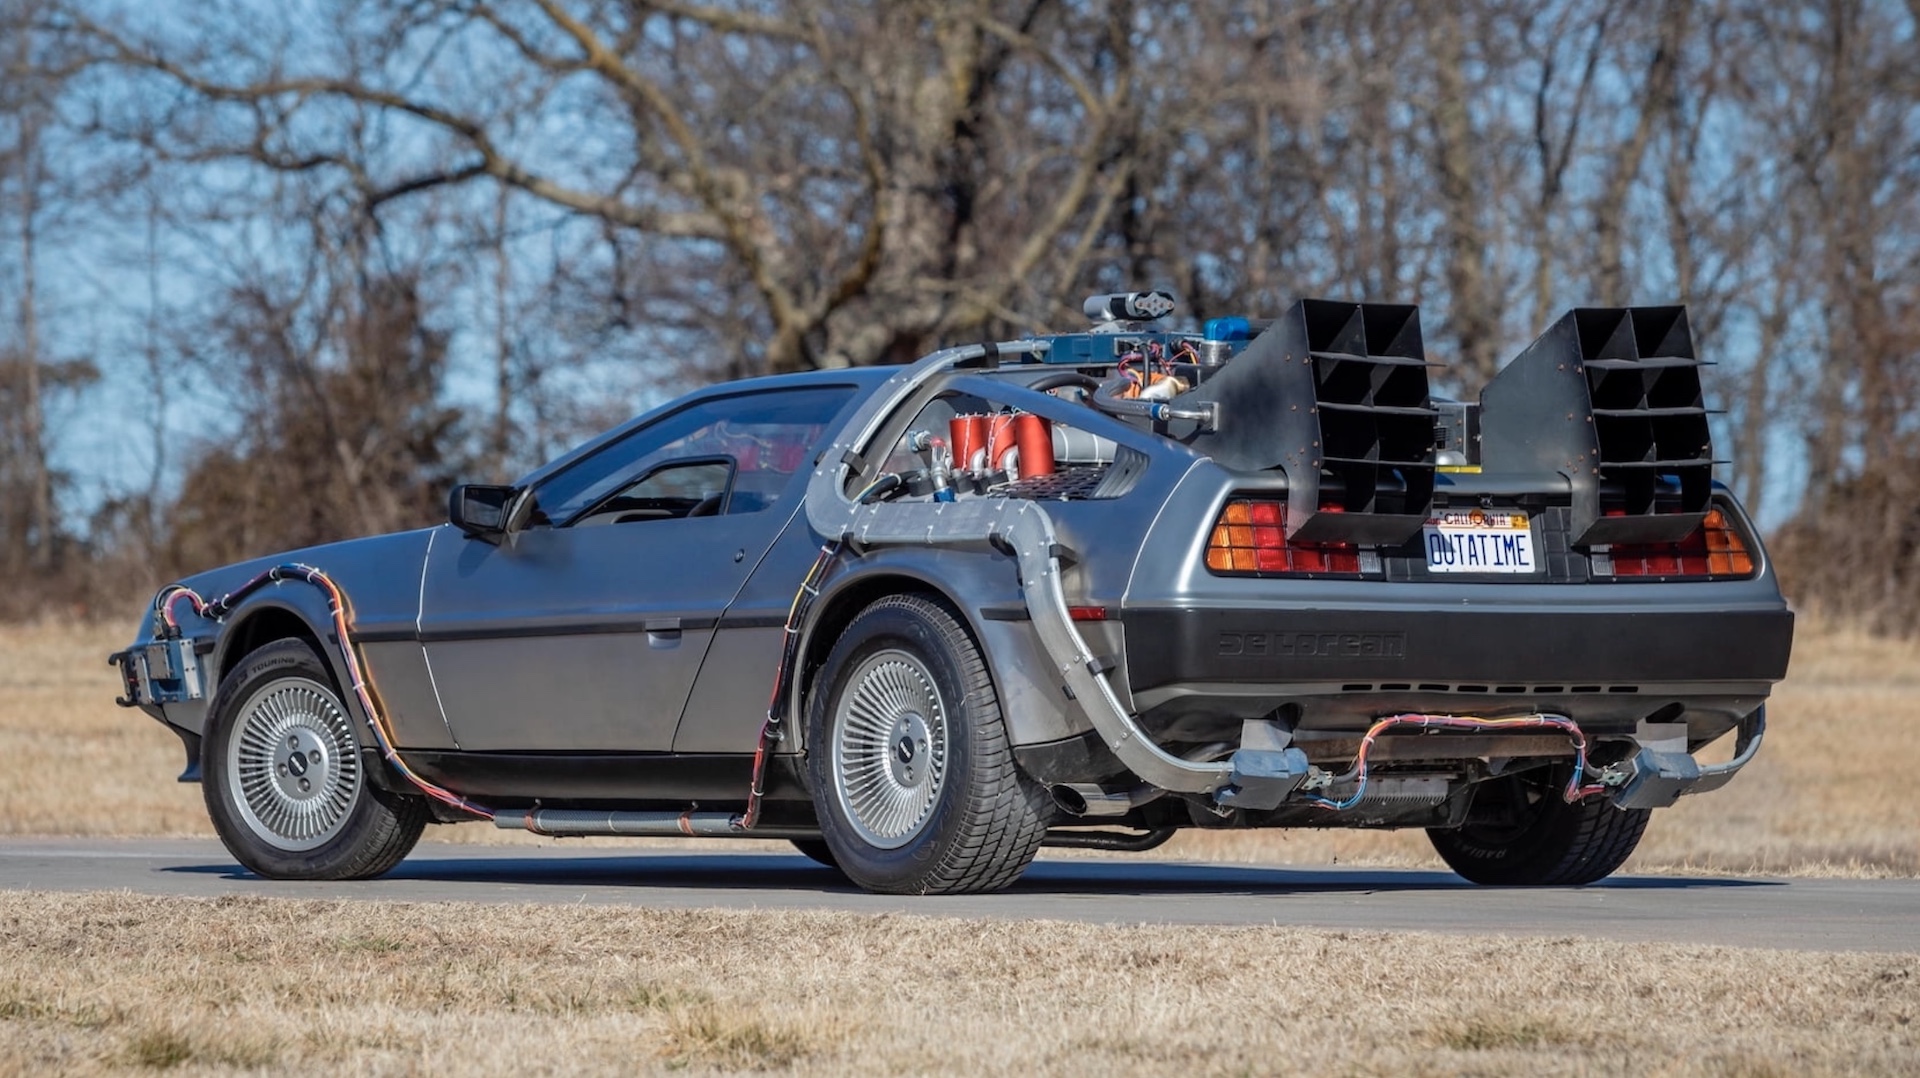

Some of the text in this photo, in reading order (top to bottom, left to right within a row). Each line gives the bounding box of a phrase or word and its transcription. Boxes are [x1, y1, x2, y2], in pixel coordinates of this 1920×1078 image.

[1444, 512, 1506, 526] CALIFORNIA
[1429, 534, 1530, 566] OUTATIME
[251, 657, 296, 674] TOURING
